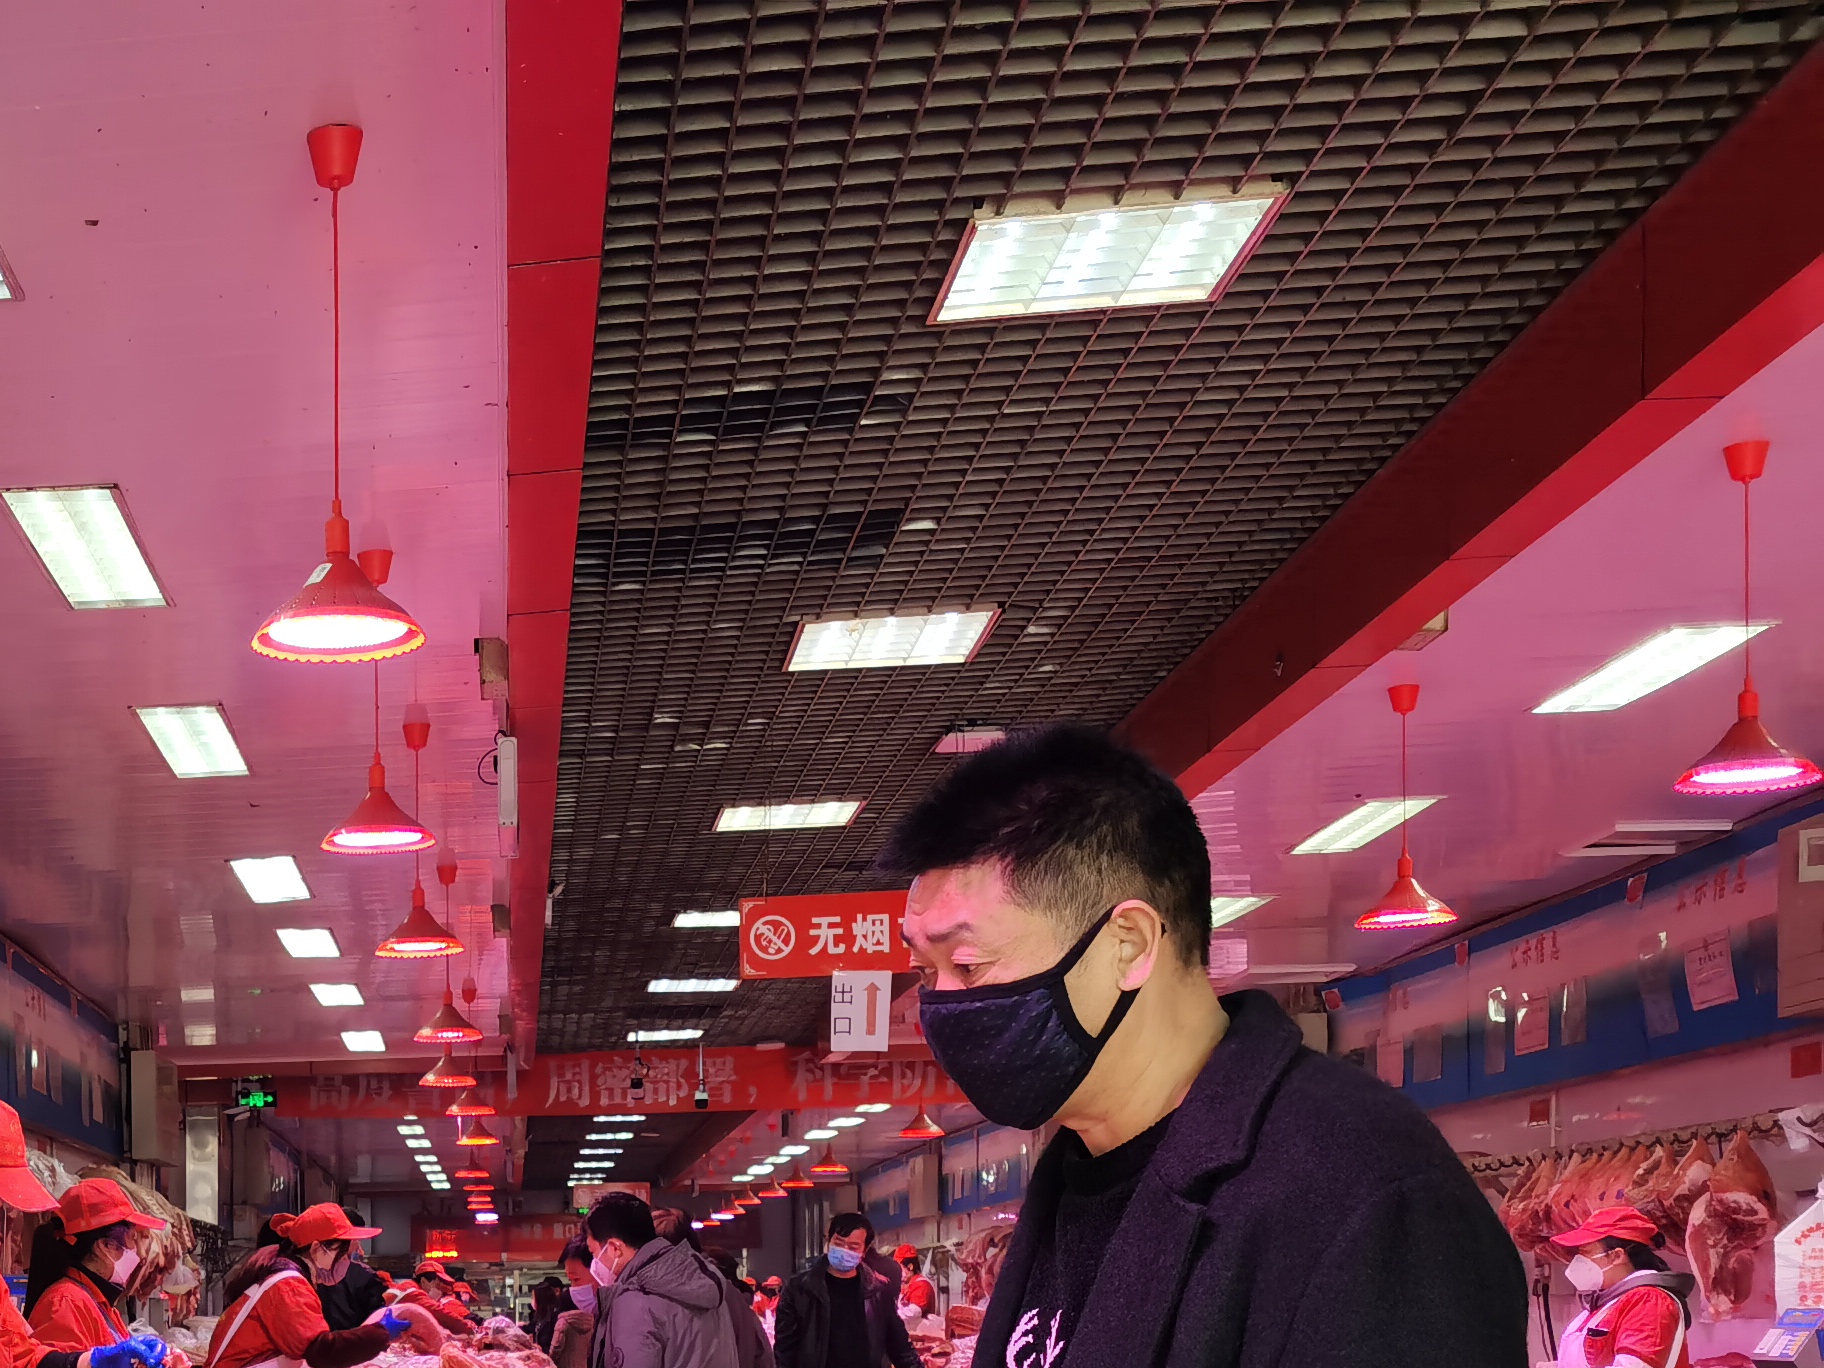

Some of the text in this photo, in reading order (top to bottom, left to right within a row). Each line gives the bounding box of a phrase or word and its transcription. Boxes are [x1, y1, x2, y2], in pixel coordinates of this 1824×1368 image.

[1677, 856, 1747, 913] 公示信息
[808, 913, 908, 956] 无烟
[832, 982, 854, 1036] 出口
